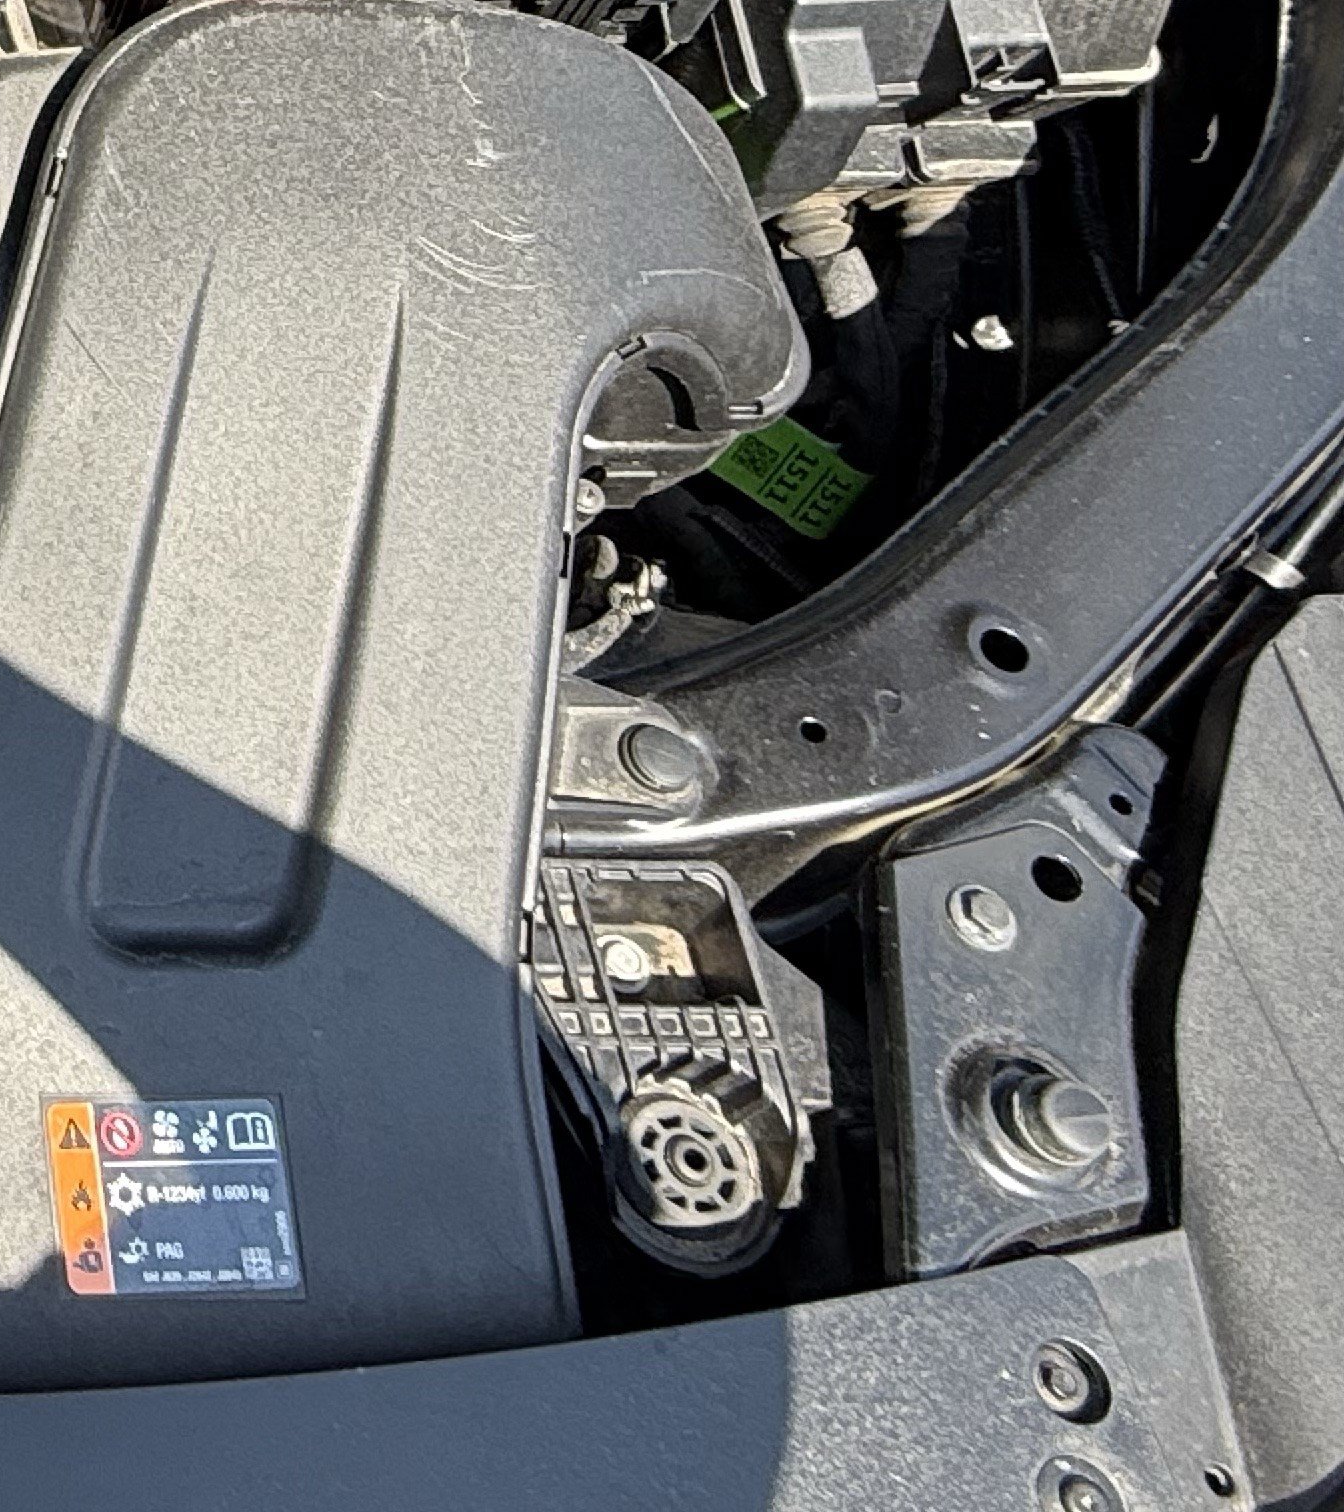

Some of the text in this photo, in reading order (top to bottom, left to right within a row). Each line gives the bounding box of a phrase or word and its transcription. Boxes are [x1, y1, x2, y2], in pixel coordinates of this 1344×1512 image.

[764, 448, 819, 504] 1511
[799, 473, 853, 527] 1511
[252, 1184, 270, 1204] kg
